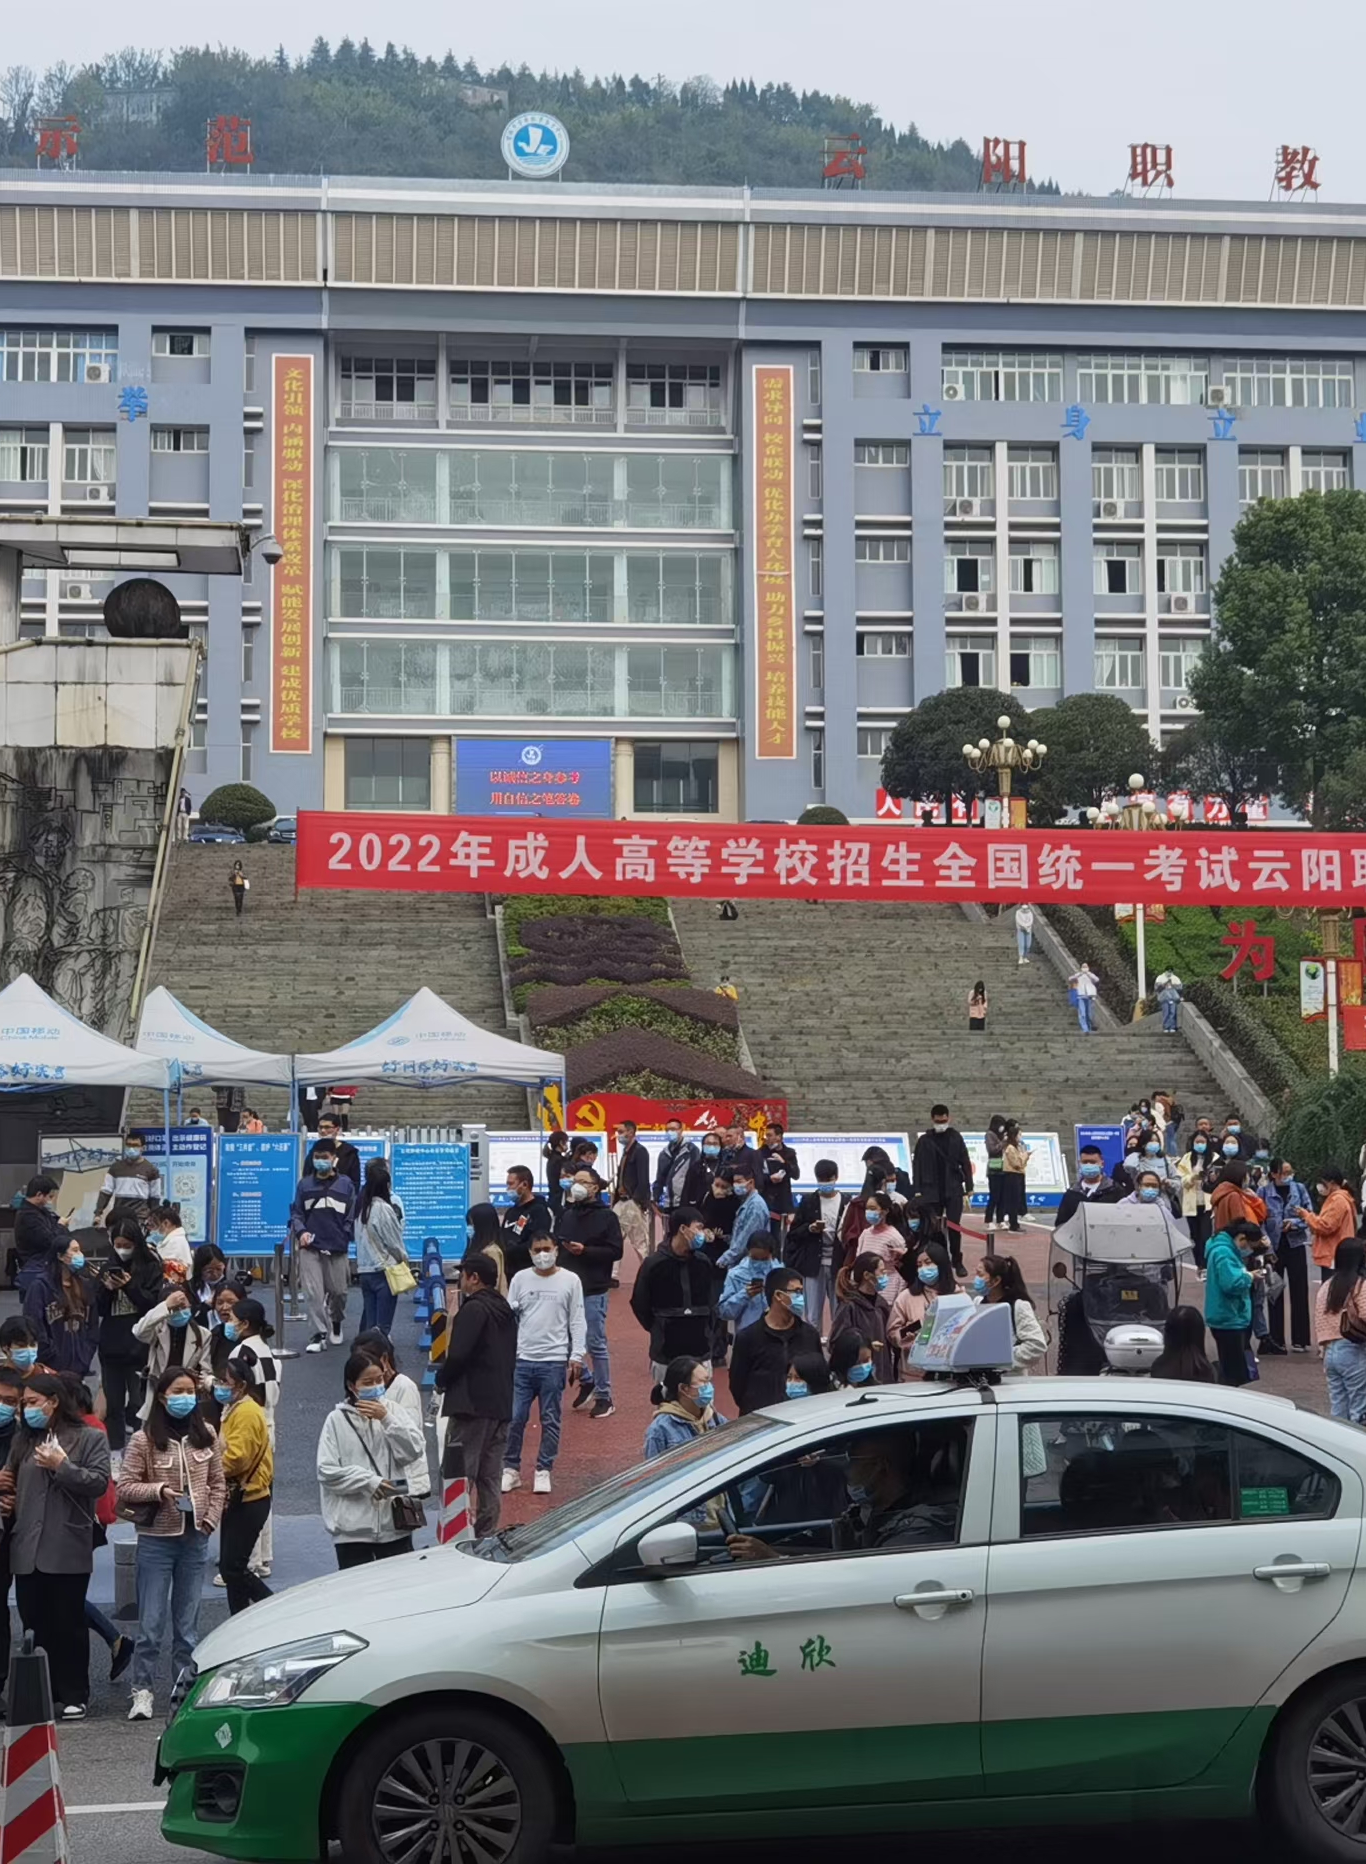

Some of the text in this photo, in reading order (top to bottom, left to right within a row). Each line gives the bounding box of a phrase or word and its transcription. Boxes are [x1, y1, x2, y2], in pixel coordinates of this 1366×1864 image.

[822, 134, 1322, 193] 云阳职教
[283, 368, 304, 416] 文化引领
[763, 377, 784, 425] 需求导向
[765, 592, 786, 664] 助力乡村振兴
[280, 665, 302, 739] 建成优质学校
[765, 671, 787, 744] 培养技能人才
[1, 1026, 61, 1035] 中国移动
[737, 1634, 836, 1678] 迪欣
